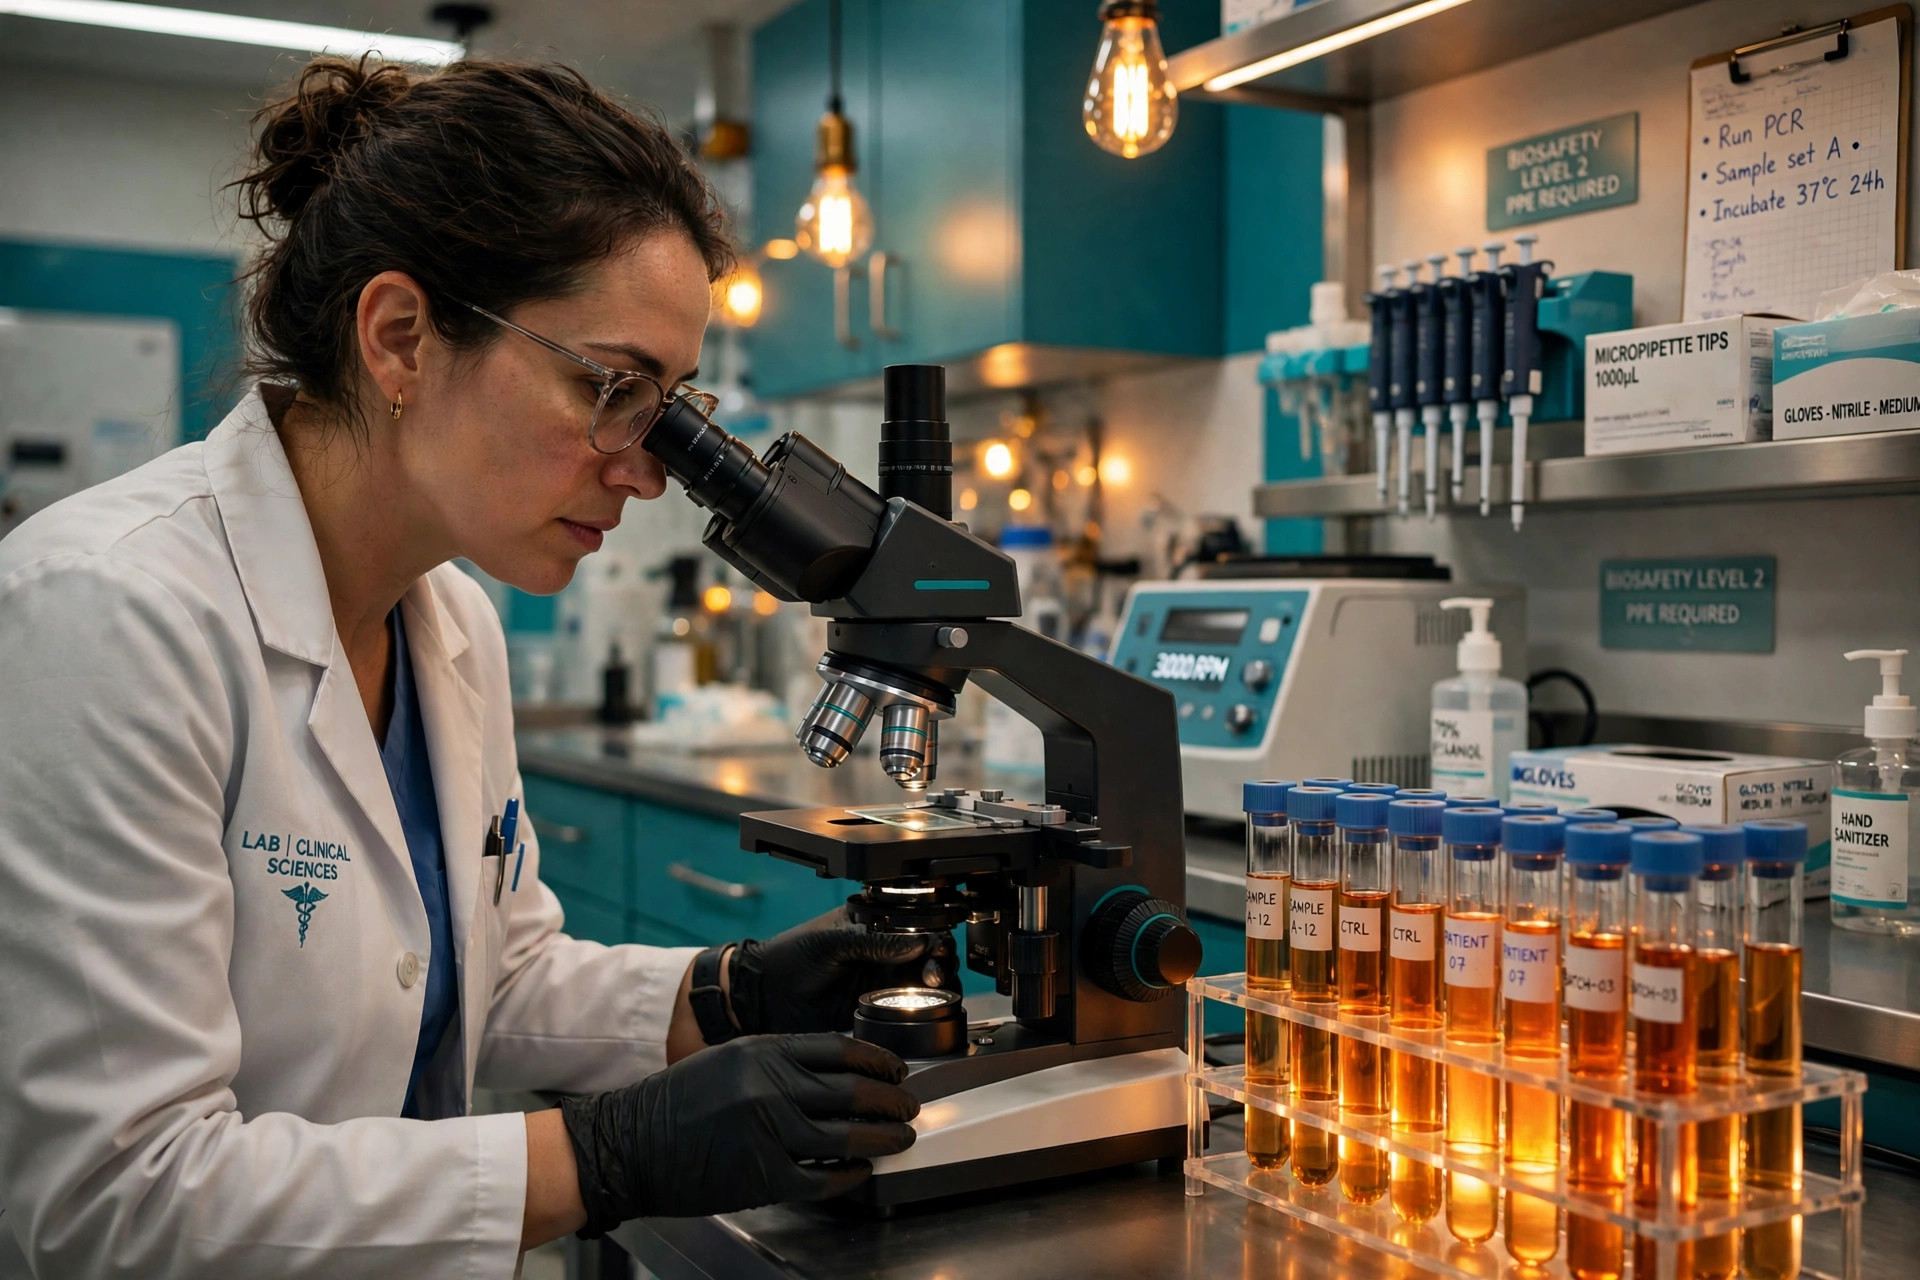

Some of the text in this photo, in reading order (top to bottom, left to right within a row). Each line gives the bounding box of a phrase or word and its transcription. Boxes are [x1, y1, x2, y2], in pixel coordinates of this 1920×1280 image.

[1719, 108, 1805, 150] Run PCR
[1507, 129, 1602, 171] BIOSAFETY
[1716, 136, 1841, 186] Sample set A
[1521, 156, 1588, 189] LEVEL 2
[1506, 174, 1620, 216] PPE REQUIRED
[1712, 169, 1885, 222] Incubate 37°C 24h
[1595, 336, 1693, 365] MICROPIPETTE
[1697, 331, 1729, 352] TIPS
[1784, 406, 1823, 423] GLOVES
[1832, 401, 1870, 419] NITRILE
[1605, 568, 1764, 590] BIOSAFETY LEVEL 2
[1626, 603, 1740, 626] PPE REQUIRED
[1521, 767, 1576, 789] GLOVES
[1739, 782, 1775, 797] GLOVES
[1841, 811, 1873, 828] HAND
[242, 830, 281, 852] LAB
[296, 839, 351, 862] CLINICAL
[1835, 827, 1889, 848] SANITIZER
[267, 857, 338, 880] SCIENCES
[1247, 909, 1272, 926] A-12
[1291, 920, 1318, 937] A-12
[1340, 919, 1370, 936] CTRL
[1393, 928, 1422, 943] CTRL
[1444, 929, 1489, 949] PATIENT
[1449, 955, 1466, 972] 07
[1503, 942, 1549, 963] PATIENT
[1509, 969, 1525, 985] 07
